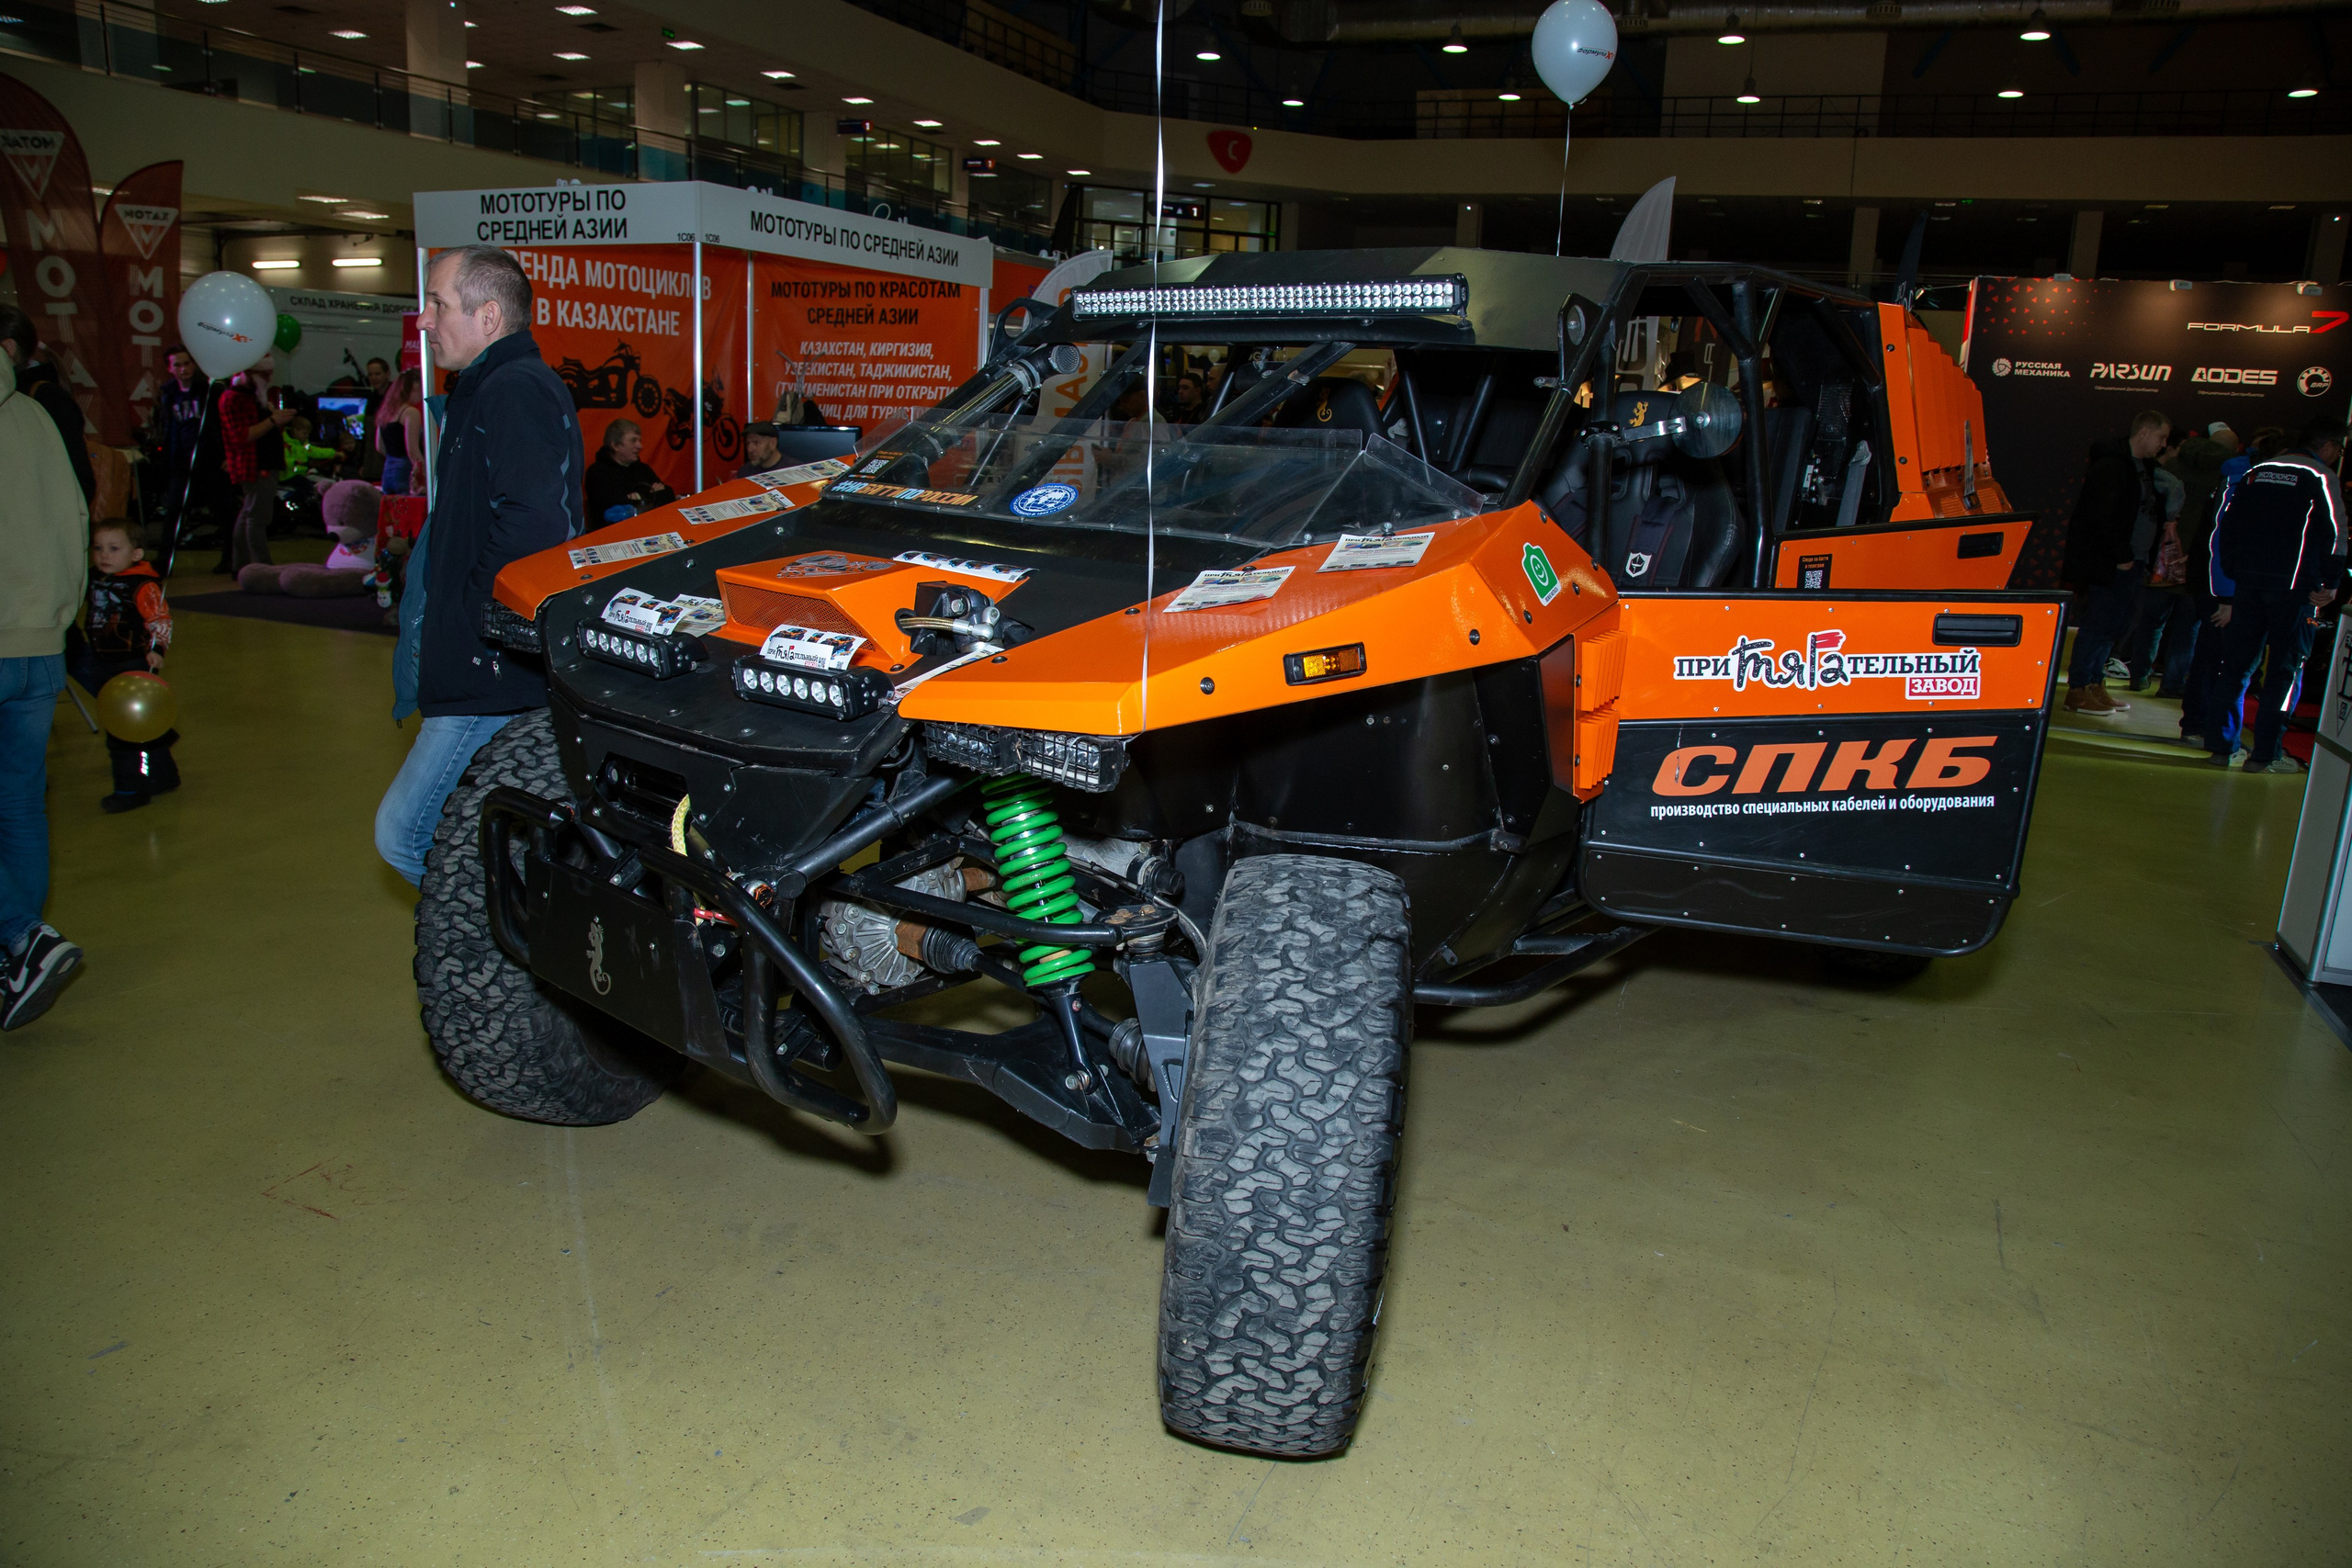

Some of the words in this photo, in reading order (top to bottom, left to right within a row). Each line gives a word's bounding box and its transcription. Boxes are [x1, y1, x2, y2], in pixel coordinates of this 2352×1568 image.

[481, 191, 590, 214] МОТОТУРЫ
[597, 189, 627, 211] ПО
[477, 214, 564, 243] СРЕДНЕЙ
[572, 218, 628, 239] АЗИИ
[751, 210, 836, 245] МОТОТУРЫ
[841, 229, 861, 250] ПО
[864, 233, 924, 260] СРЕДНЕЙ
[927, 245, 958, 267] АЗИИ
[504, 249, 580, 289] ЕНДА
[772, 281, 851, 299] МОТОТУРЫ
[855, 281, 876, 298] ПО
[879, 281, 961, 299] КРАСОТАМ
[537, 298, 550, 325] В
[557, 299, 680, 336] КАЗАХСТАНЕ
[808, 304, 874, 327] СРЕДНЕЙ
[878, 308, 919, 324] АЗИИ
[799, 342, 866, 358] КАЗАХСТАН,
[870, 343, 934, 359] КИРГИЗИЯ,
[860, 363, 952, 381] ТАДЖИКИСТАН,
[2014, 368, 2071, 378] МЕХАНИКА
[2015, 361, 2062, 370] РУССКАЯ
[2089, 362, 2172, 381] PARSUN
[868, 383, 895, 399] ПРИ
[896, 385, 960, 400] ОТКРЫТИ
[843, 405, 868, 421] ДЛЯ
[1911, 679, 1976, 695] ЗАВОД
[1652, 736, 1998, 796] СПКБ
[1650, 802, 1740, 819] производство
[1742, 799, 1830, 816] специальных
[1832, 796, 1886, 810] кабелей
[1889, 798, 1897, 809] и
[1899, 794, 1996, 813] оборудования
